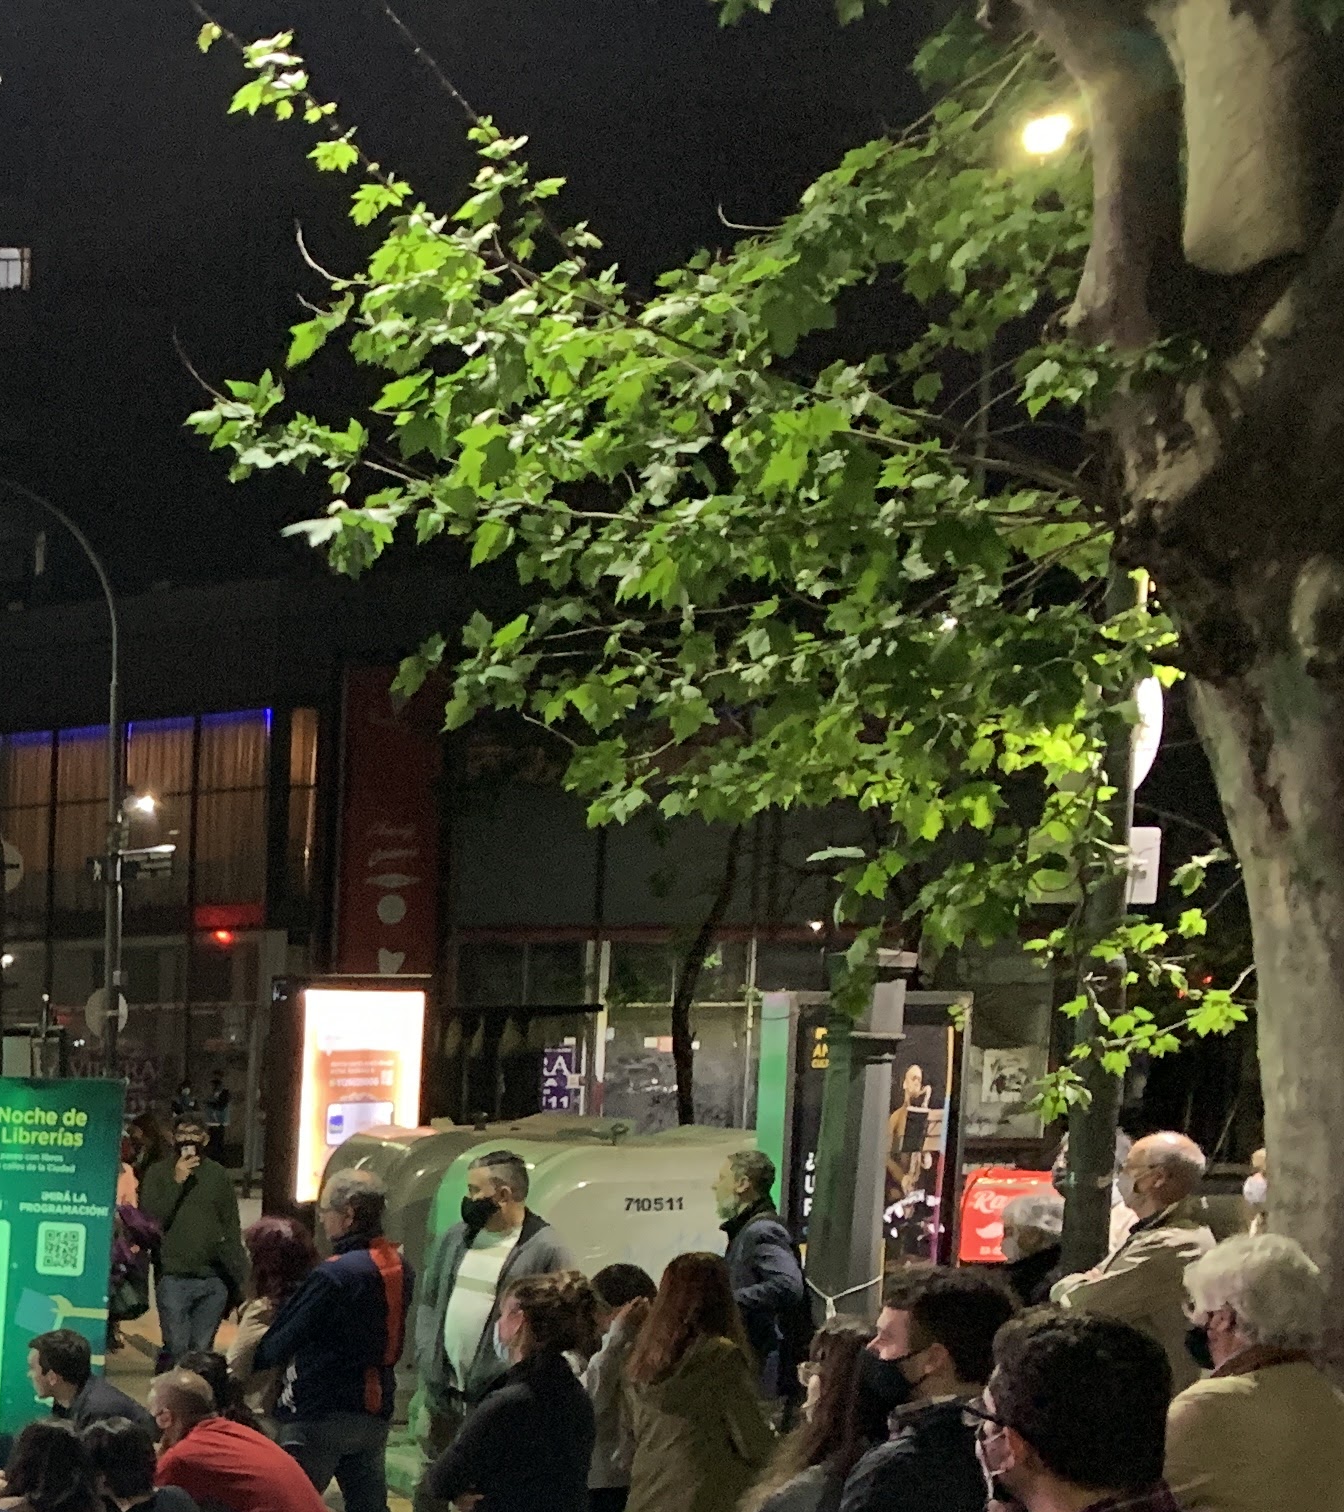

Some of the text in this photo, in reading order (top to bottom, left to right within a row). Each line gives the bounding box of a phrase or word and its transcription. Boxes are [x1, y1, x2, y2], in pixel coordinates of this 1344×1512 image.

[62, 1108, 88, 1127] de
[1, 1126, 84, 1147] Librerías
[73, 1193, 87, 1203] LA
[625, 1196, 684, 1212] 710511
